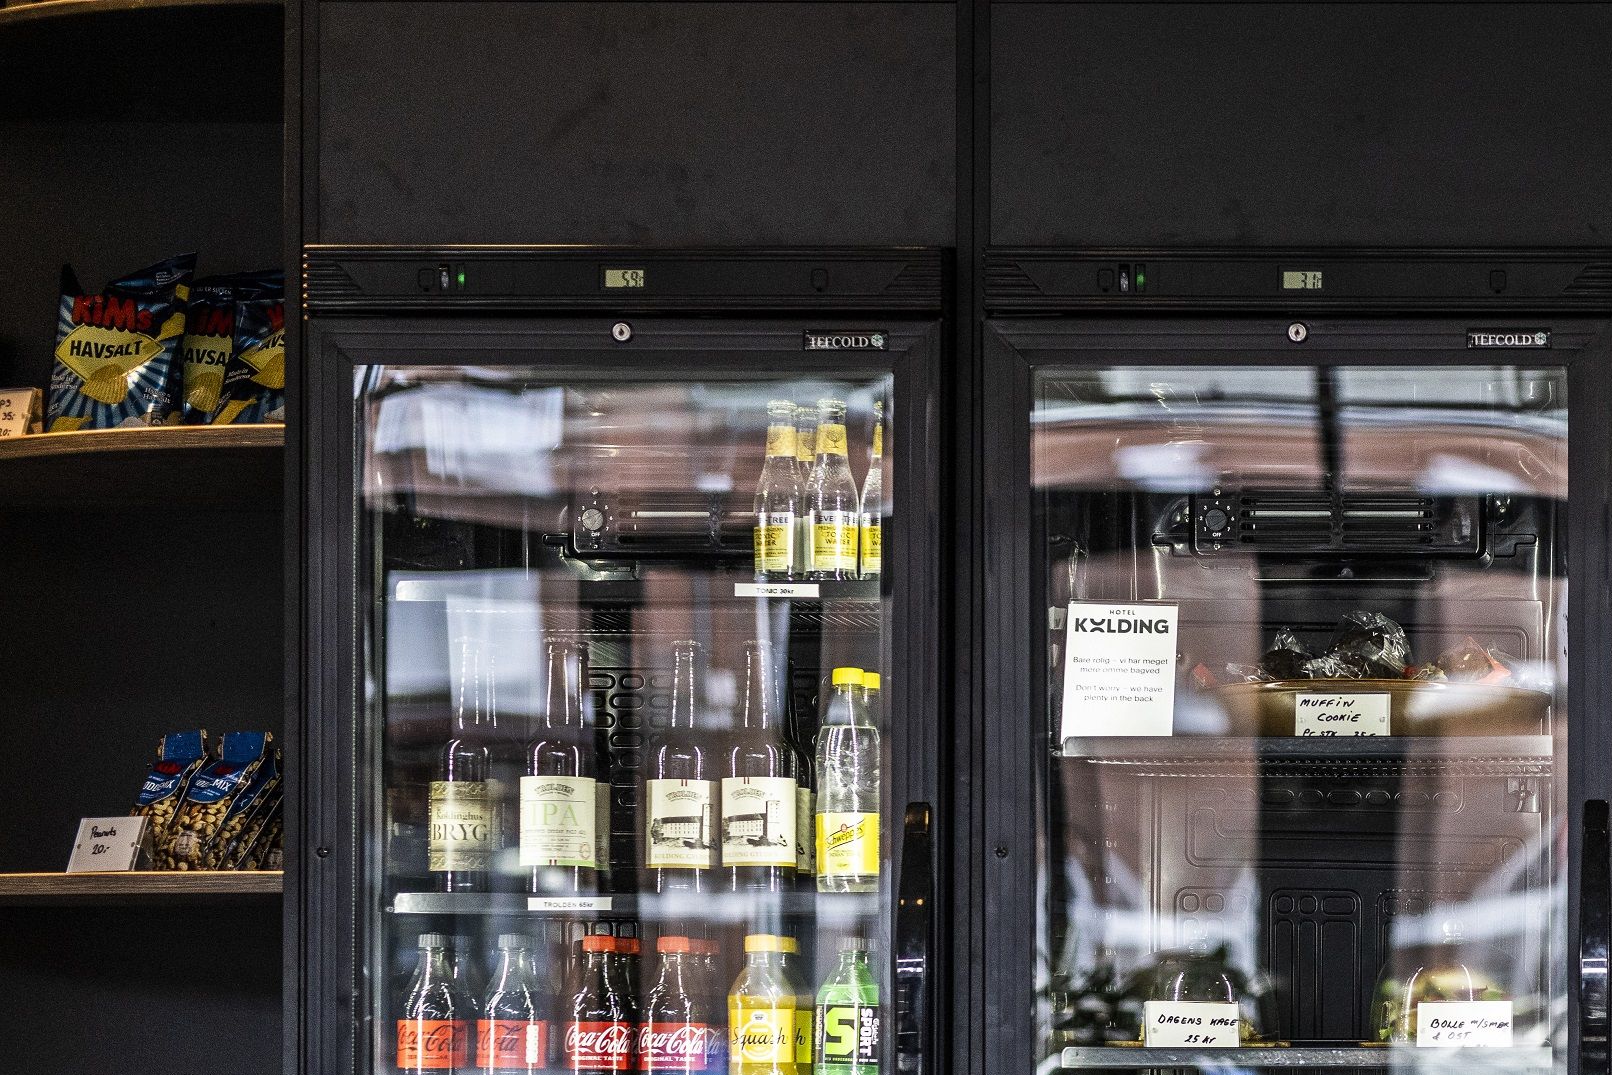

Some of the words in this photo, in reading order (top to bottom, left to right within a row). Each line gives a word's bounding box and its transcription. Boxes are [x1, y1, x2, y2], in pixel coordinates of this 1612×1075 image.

[70, 340, 142, 358] HAVSALT
[809, 336, 869, 348] TEFCOLD
[1472, 334, 1532, 346] TEFCOLD
[531, 802, 580, 827] IPA
[90, 826, 117, 840] Peanuts
[432, 823, 488, 843] BRYG
[1158, 1014, 1202, 1026] DAGENS
[565, 1025, 631, 1054] Coca-Cola
[638, 1025, 706, 1054] Coca-Cola
[860, 1008, 873, 1057] SPORT
